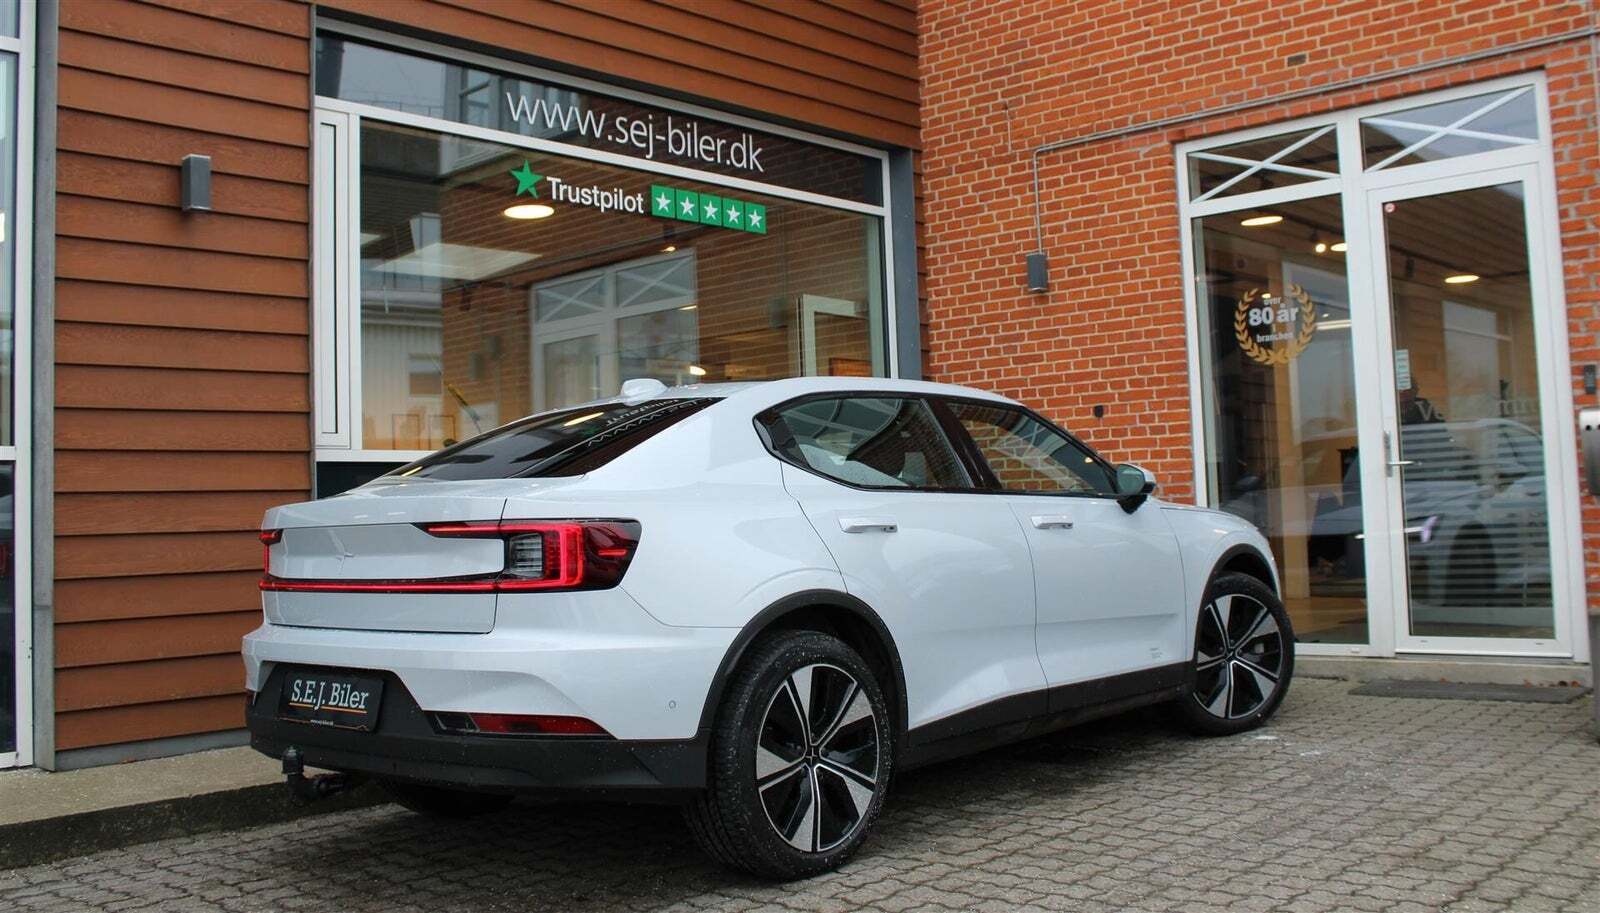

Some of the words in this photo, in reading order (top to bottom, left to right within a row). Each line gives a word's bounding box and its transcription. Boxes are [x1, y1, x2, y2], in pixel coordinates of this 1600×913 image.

[506, 92, 764, 173] www.sej-biler.dk
[546, 176, 644, 214] Trustpilot
[1248, 306, 1274, 326] 80
[1276, 303, 1299, 323] år
[291, 679, 326, 710] S.E.J.
[328, 682, 369, 709] Biler
